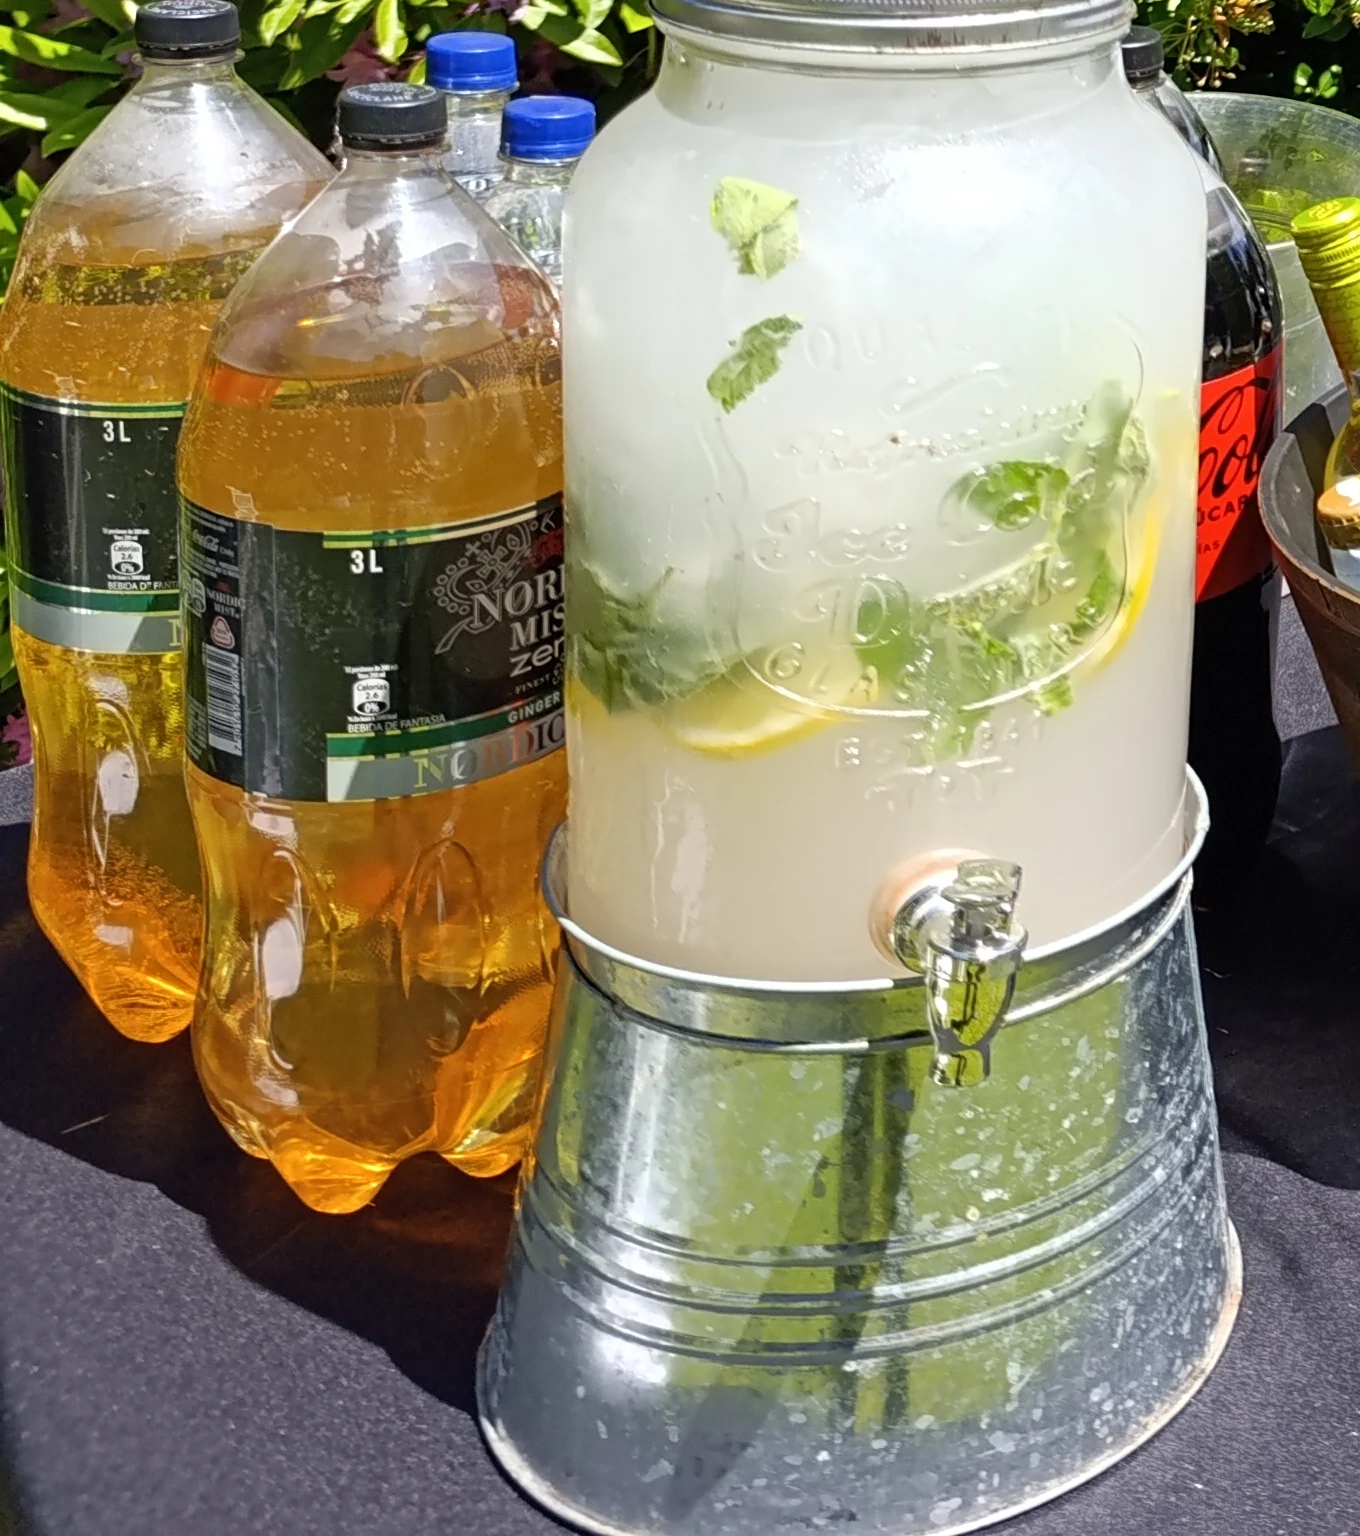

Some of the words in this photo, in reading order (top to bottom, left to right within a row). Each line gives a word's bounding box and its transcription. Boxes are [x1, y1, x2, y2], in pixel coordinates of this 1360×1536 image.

[508, 691, 561, 724] GINGER
[347, 723, 383, 733] BEBIDA
[385, 721, 398, 730] DE
[400, 714, 447, 729] FANTASIA
